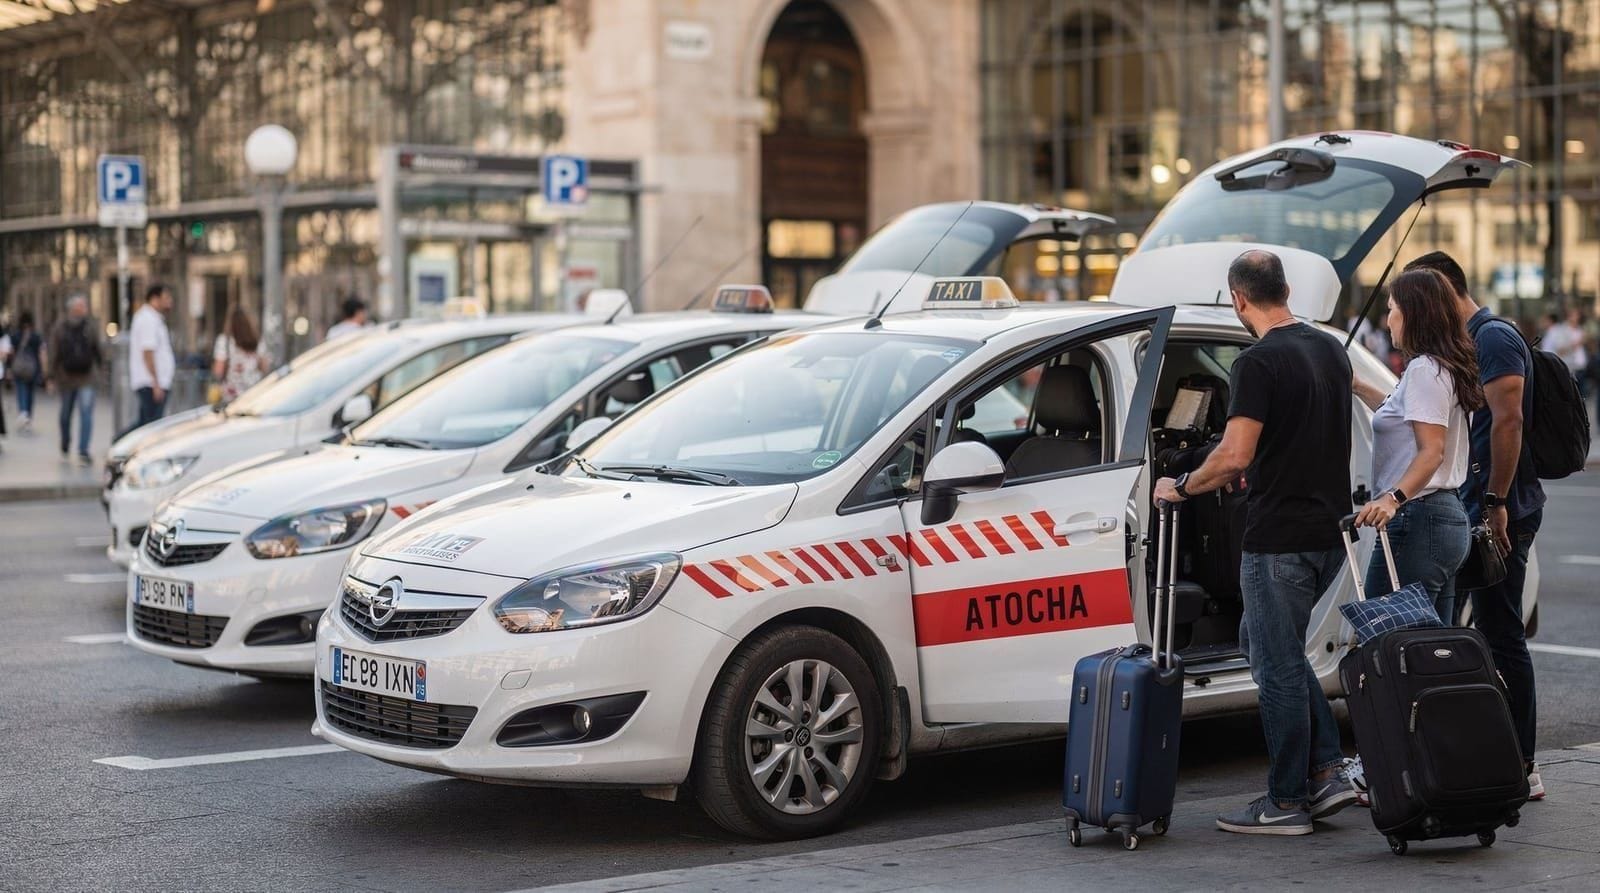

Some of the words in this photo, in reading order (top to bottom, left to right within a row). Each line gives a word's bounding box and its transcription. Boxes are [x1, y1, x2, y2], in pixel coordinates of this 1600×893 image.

[106, 161, 132, 201] P
[552, 158, 579, 201] P
[935, 282, 974, 300] TAXI
[965, 584, 1089, 632] ATOCHA
